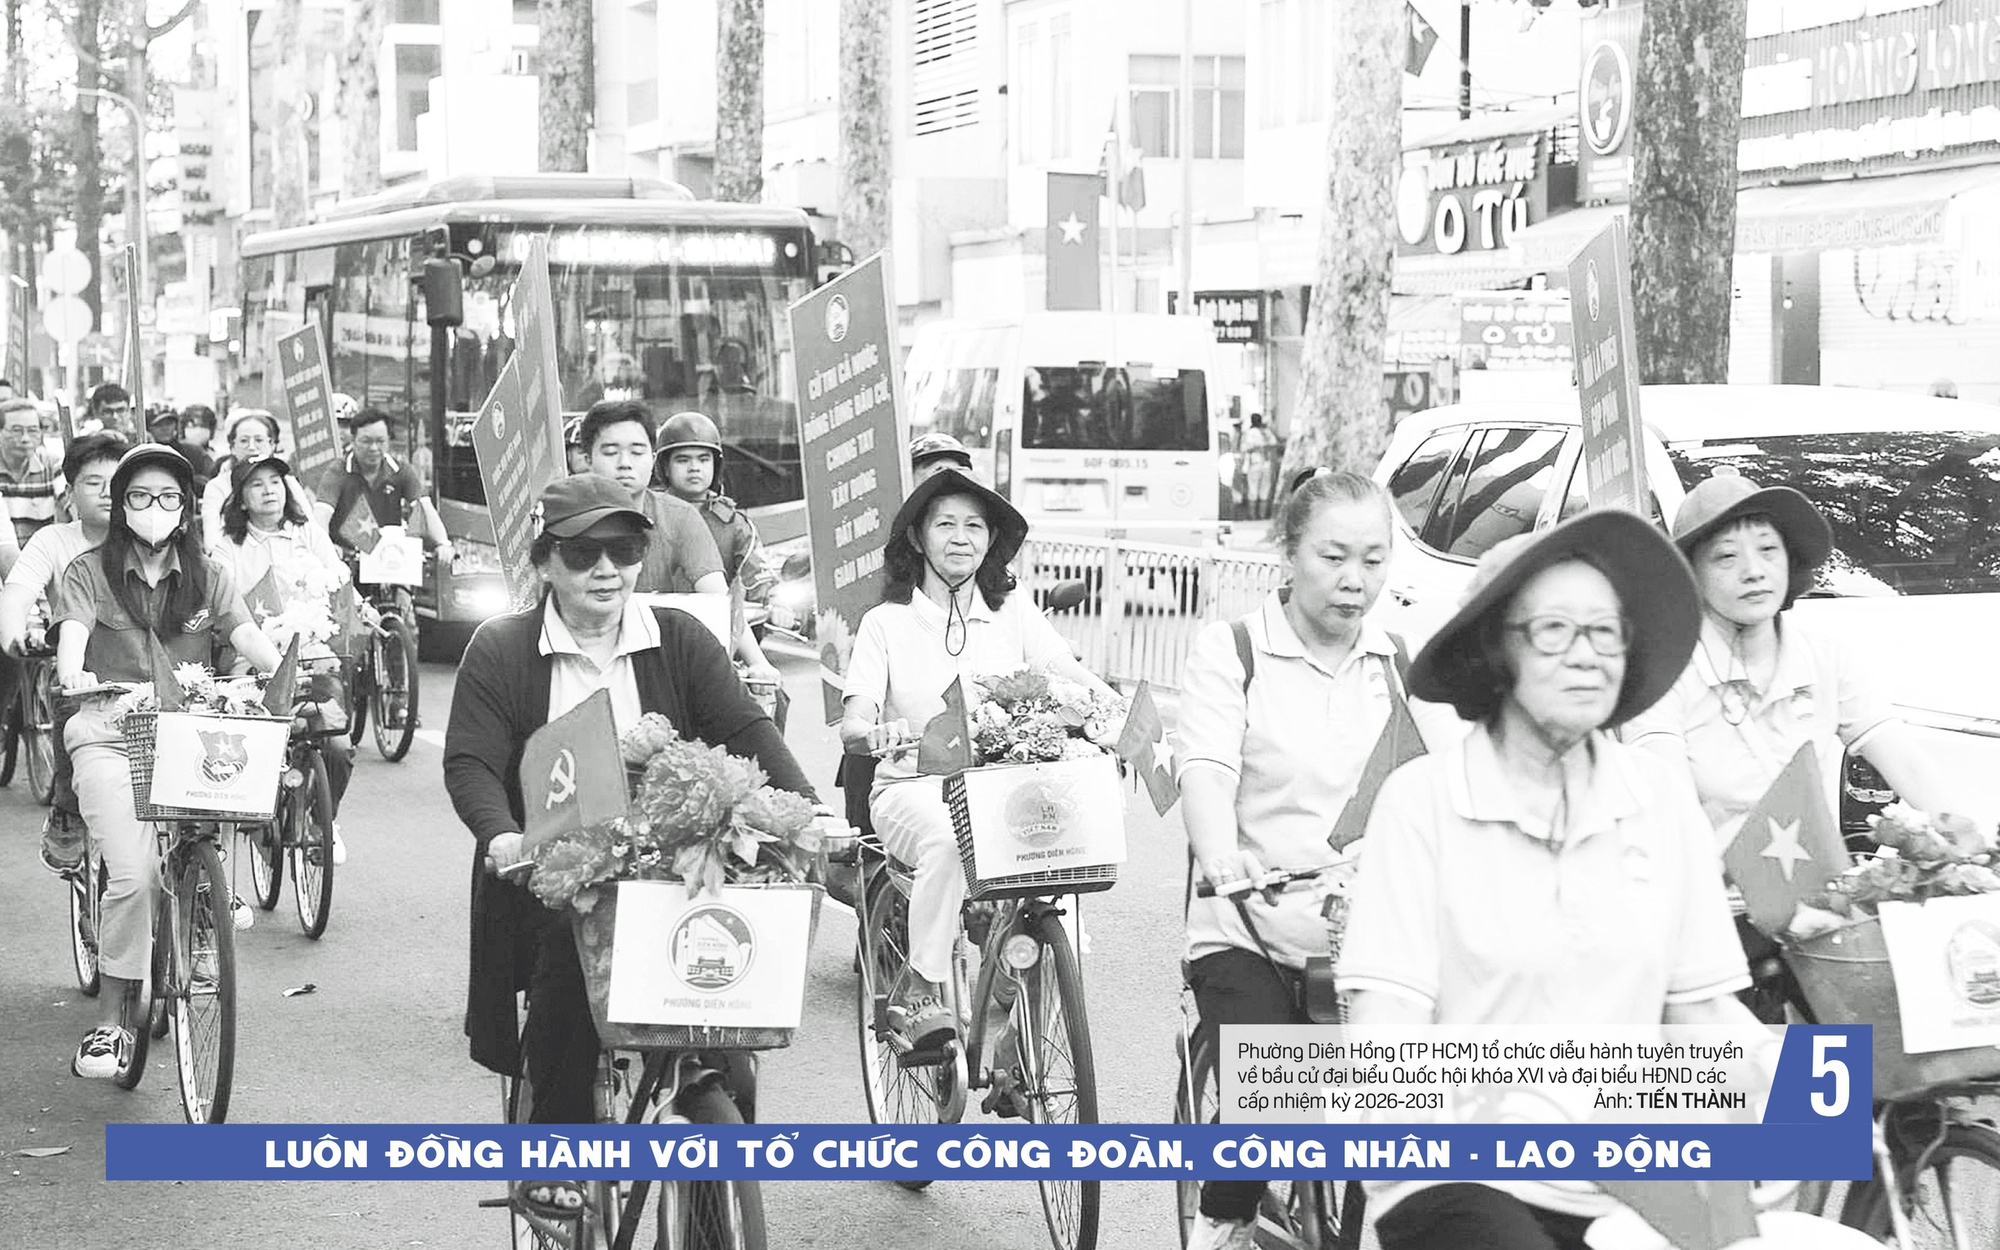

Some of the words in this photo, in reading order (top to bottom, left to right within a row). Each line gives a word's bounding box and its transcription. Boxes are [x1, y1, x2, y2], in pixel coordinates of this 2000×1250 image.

[1434, 194, 1465, 254] O
[1472, 181, 1527, 249] TÚ
[826, 437, 858, 471] CHUNG
[857, 428, 874, 455] TAY
[831, 481, 849, 510] XÂY
[850, 468, 877, 501] DỰNG
[853, 507, 879, 539] NƯỚC
[663, 996, 701, 1008] PHƯỜNG
[704, 997, 725, 1010] DIÊN
